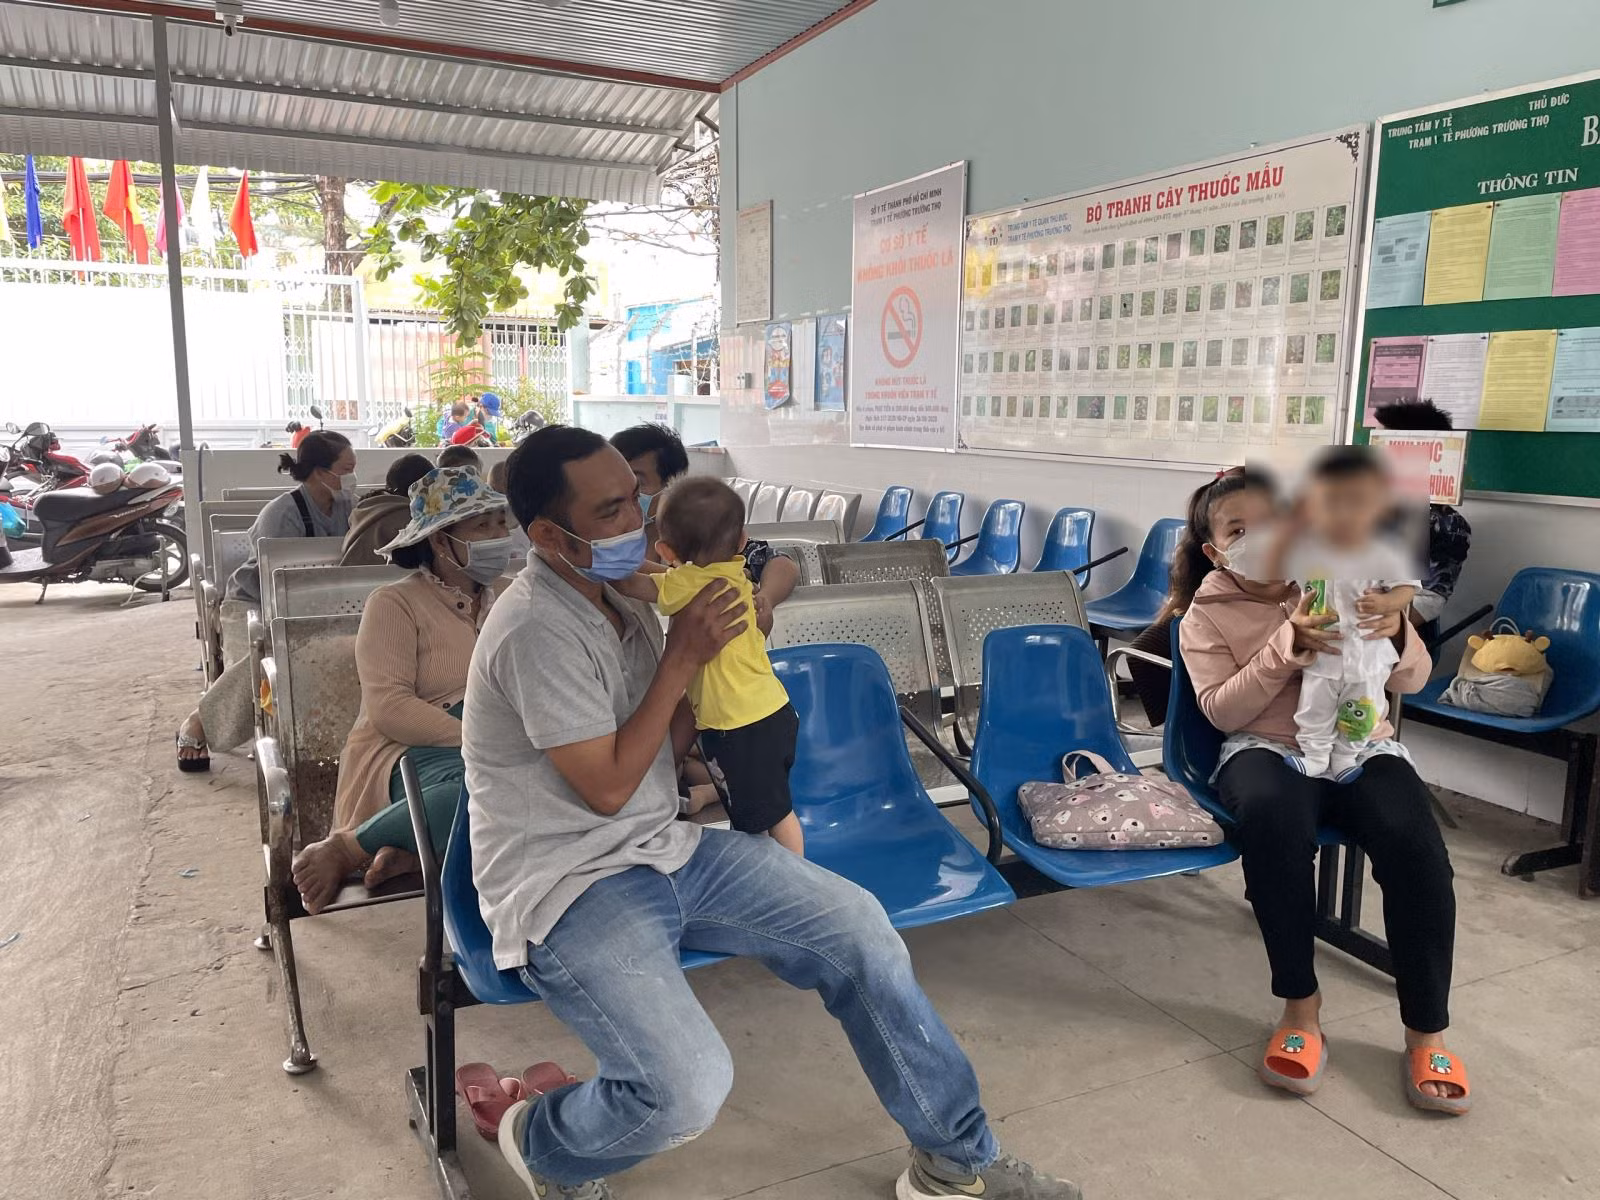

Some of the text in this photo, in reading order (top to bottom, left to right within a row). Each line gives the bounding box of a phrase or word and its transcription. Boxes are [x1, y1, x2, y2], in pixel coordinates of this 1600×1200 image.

[1387, 125, 1413, 139] TRUNG
[1434, 119, 1440, 129] Y
[1443, 113, 1453, 127] TẾ
[1529, 95, 1548, 111] THỦ
[1409, 136, 1432, 150] TRẠM
[1443, 128, 1453, 143] TẾ
[1531, 115, 1550, 128] THỌ
[1581, 115, 1600, 147] B
[1086, 201, 1102, 224] BỘ
[1106, 194, 1152, 219] TRANH
[1156, 186, 1184, 210] CÂY
[1188, 171, 1241, 203] THUỐC
[1246, 161, 1285, 192] MẪU
[1478, 168, 1579, 195] THÔNG TIN
